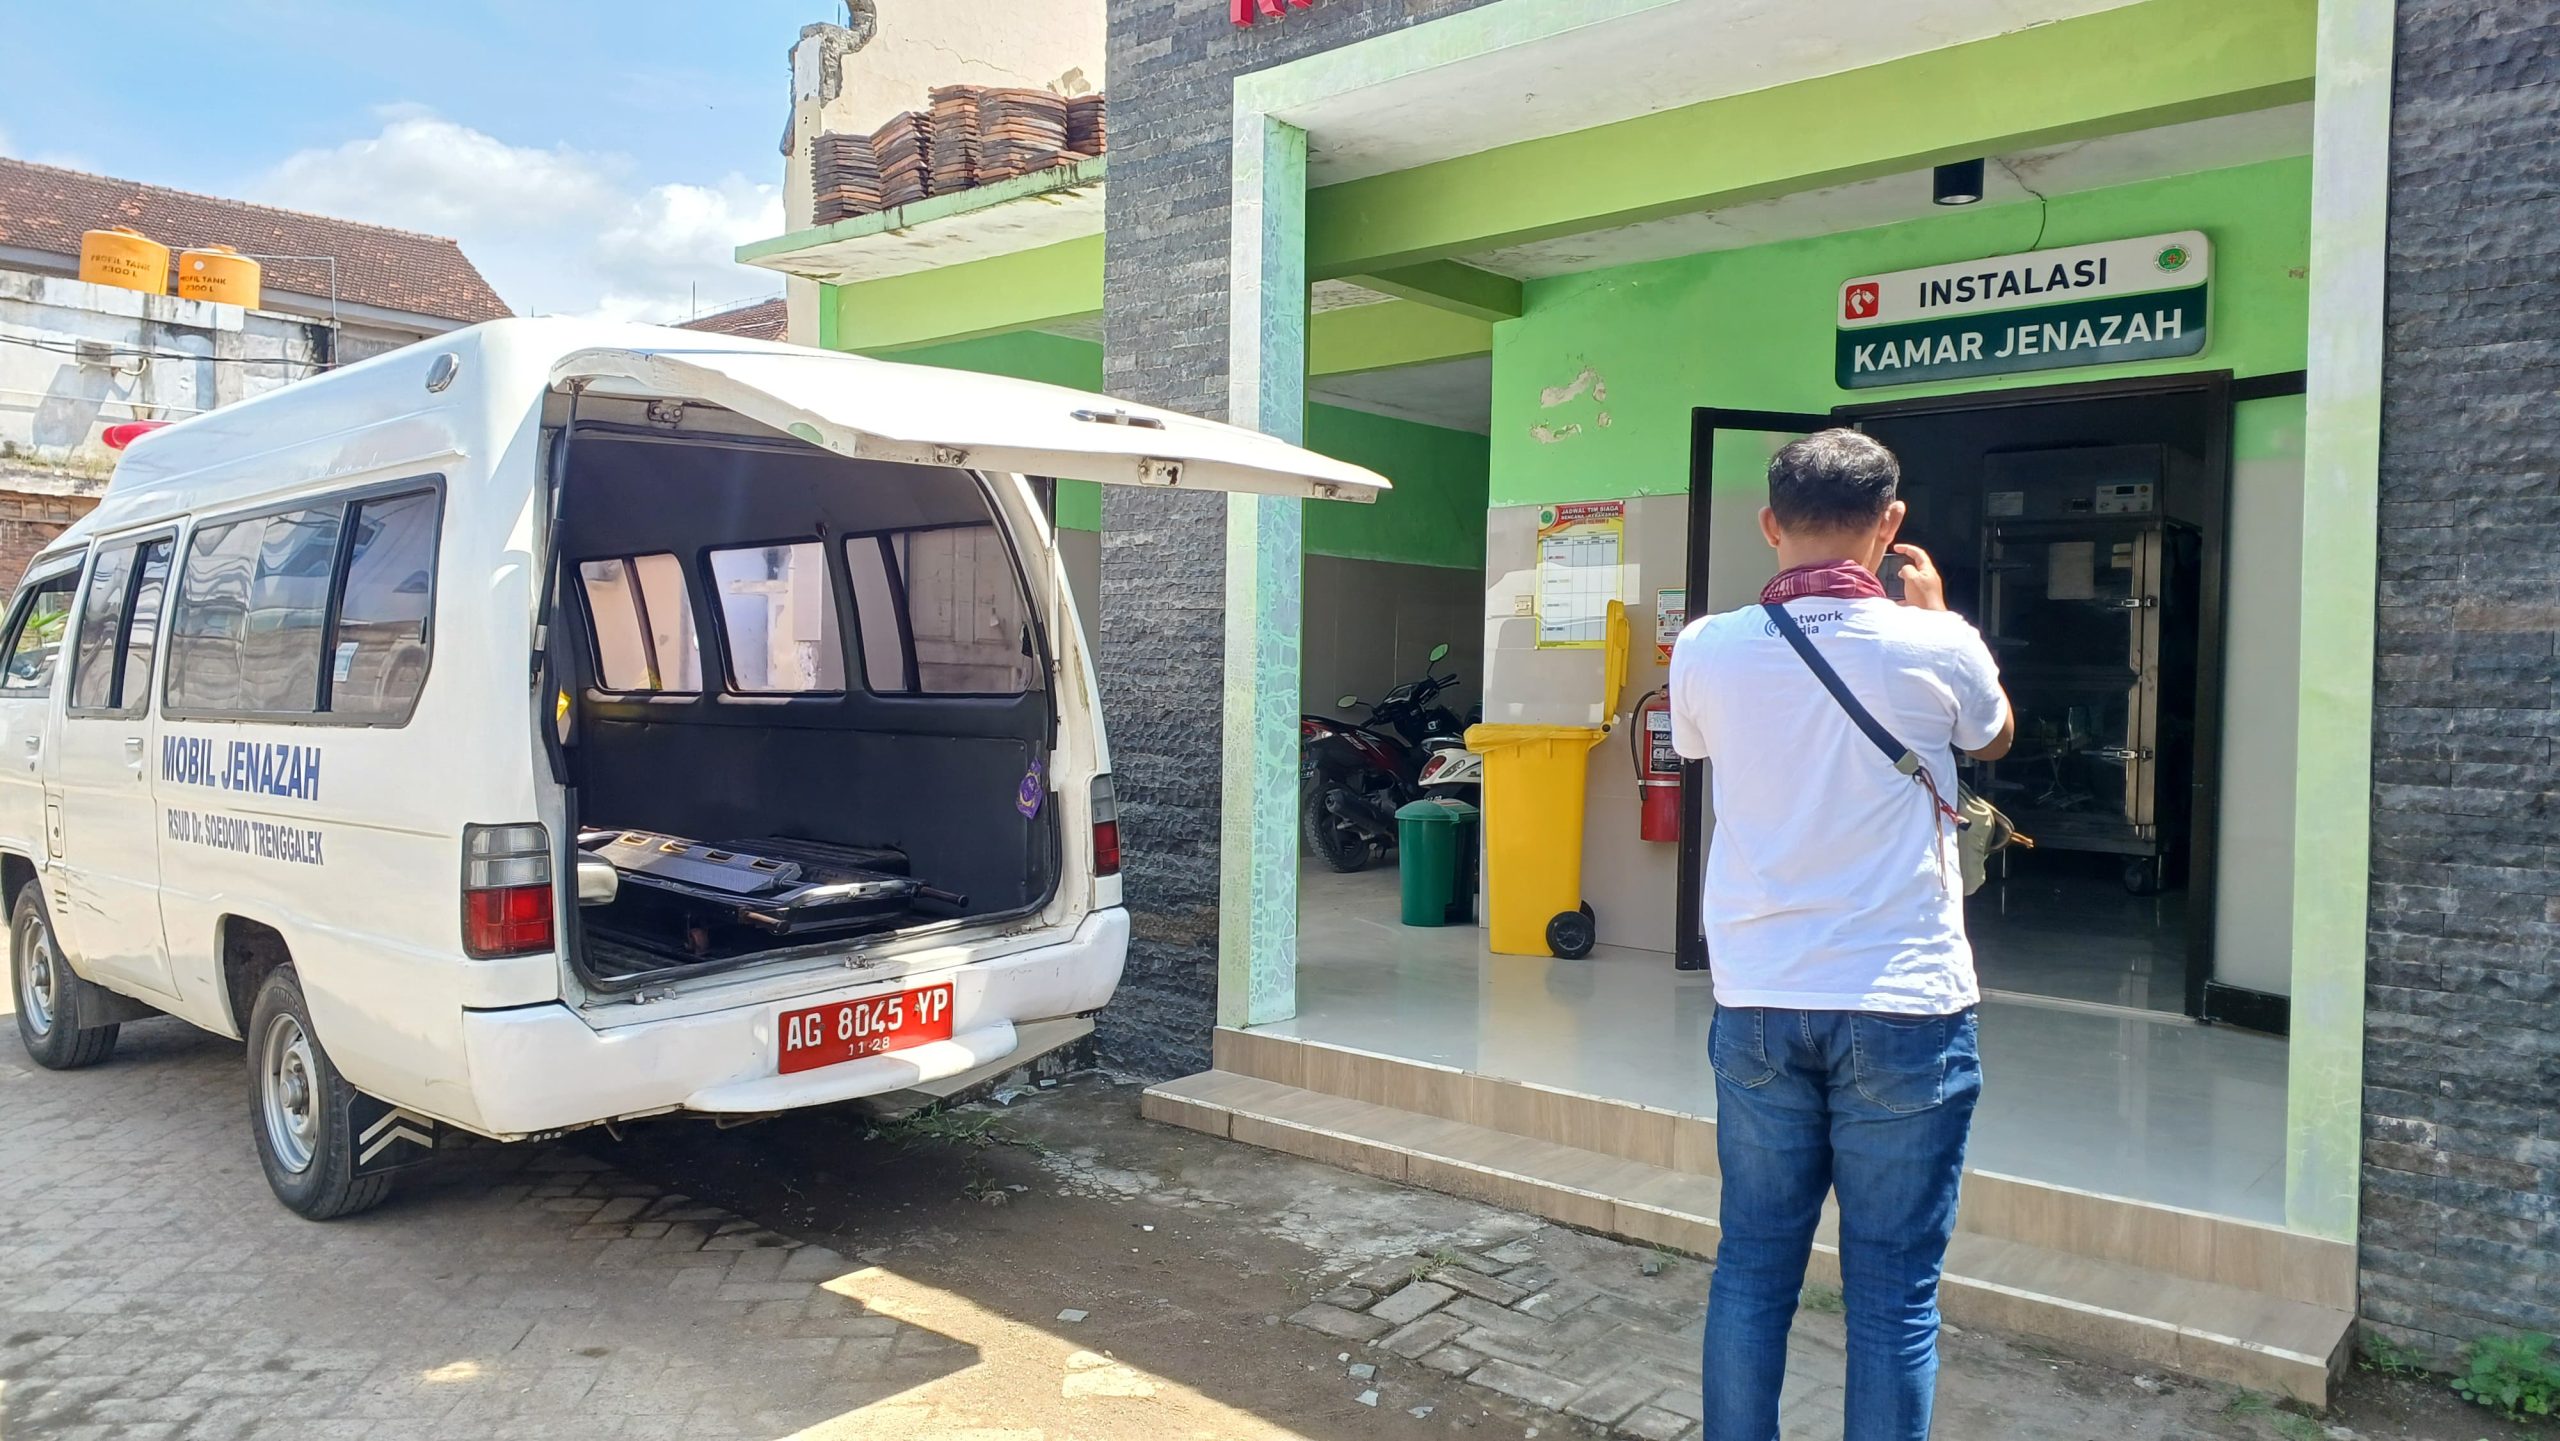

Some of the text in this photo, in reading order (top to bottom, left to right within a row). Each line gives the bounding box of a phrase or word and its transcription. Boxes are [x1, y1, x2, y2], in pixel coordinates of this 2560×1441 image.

[203, 276, 226, 285] TANK
[1919, 257, 2108, 308] INSTALASI
[1853, 308, 2182, 373] KAMAR JENAZAH
[1791, 610, 1844, 624] etwork
[162, 735, 321, 801] MOBIL JENAZAH
[168, 808, 324, 866] RSUD Dr. SOEDOMO TRENGGALEK
[786, 988, 948, 1052] AG 8045 YP
